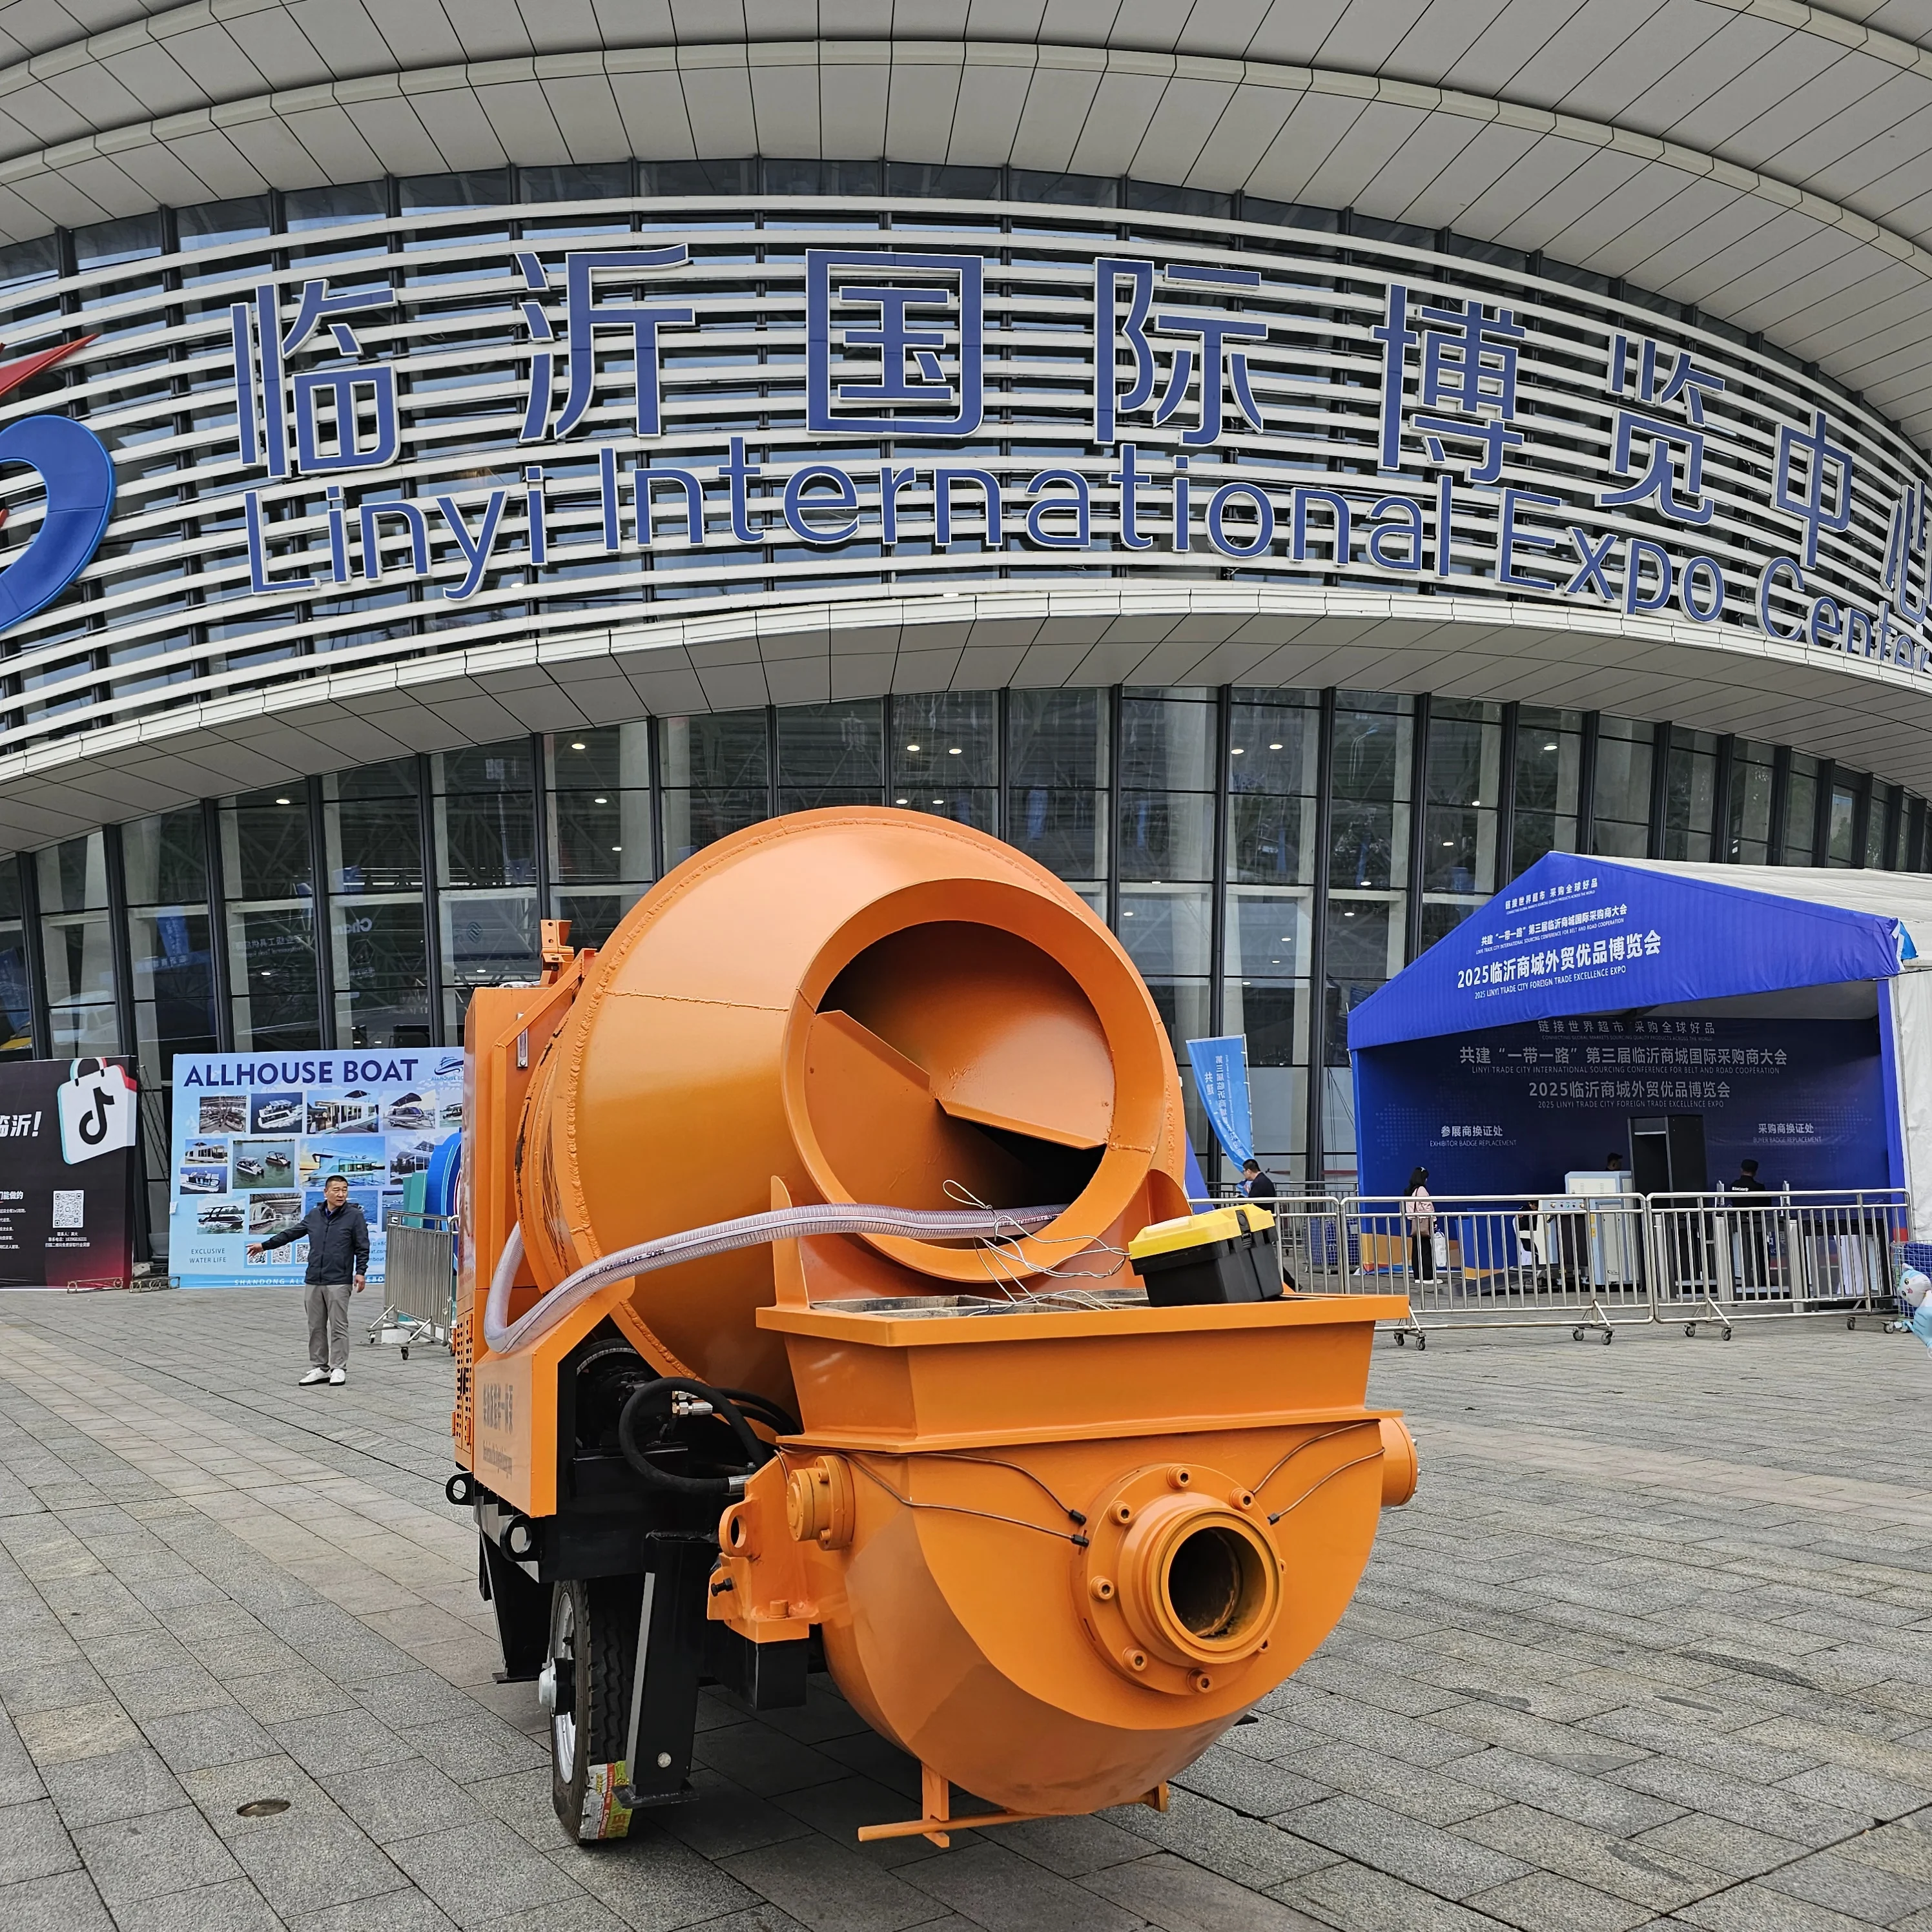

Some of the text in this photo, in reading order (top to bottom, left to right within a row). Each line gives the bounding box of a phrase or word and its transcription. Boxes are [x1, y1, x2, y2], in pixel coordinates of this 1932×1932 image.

[231, 243, 1932, 624] 临沂国际博览中心
[244, 436, 1931, 672] Linyi International Expo Center
[1505, 878, 1598, 909] 链接世界超市 采购全球好品
[1598, 918, 1624, 928] COOPERATION
[1457, 929, 1661, 989] 2025临沂商城外贸优品博览会
[1475, 965, 1626, 1000] 2025 LINYI TRADE CITY FOREIGN TRADE EXCELLENCE EXPO
[1537, 1020, 1715, 1034] 链接世界超市 采购全球好品
[183, 1059, 419, 1087] ALLHOUSE BOAT
[1529, 1081, 1731, 1098] 2025临沂商城外贸优品博览会
[1441, 1125, 1503, 1137] 参展商换证处
[1758, 1123, 1814, 1134] 采购商换证处
